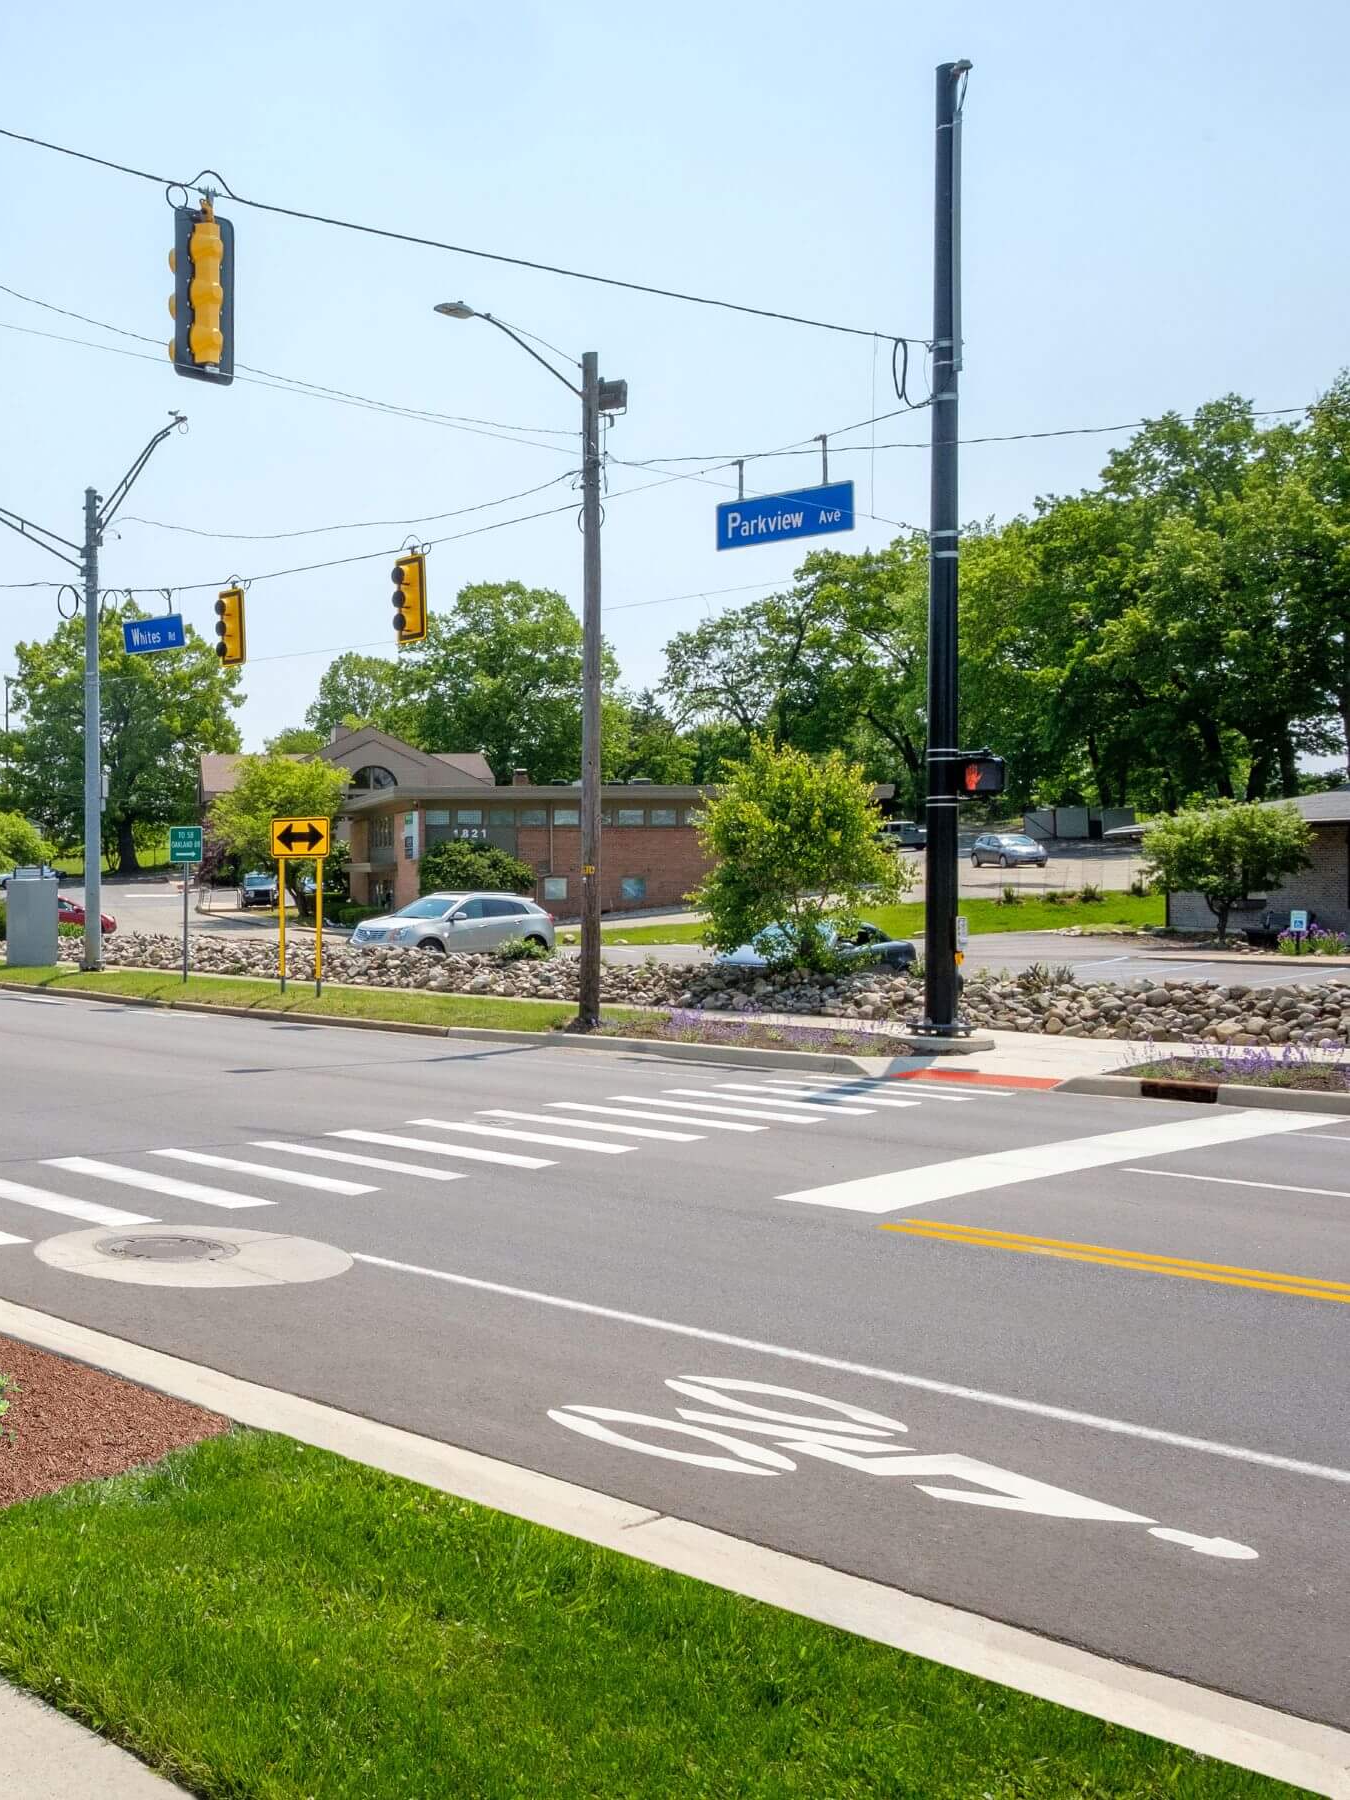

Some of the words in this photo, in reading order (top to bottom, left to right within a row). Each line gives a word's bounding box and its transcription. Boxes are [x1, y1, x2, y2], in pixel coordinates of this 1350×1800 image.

[727, 511, 804, 540] Parkview
[818, 510, 841, 525] Ave
[131, 627, 161, 647] Whites
[168, 631, 176, 641] Rd
[453, 829, 487, 838] 1821
